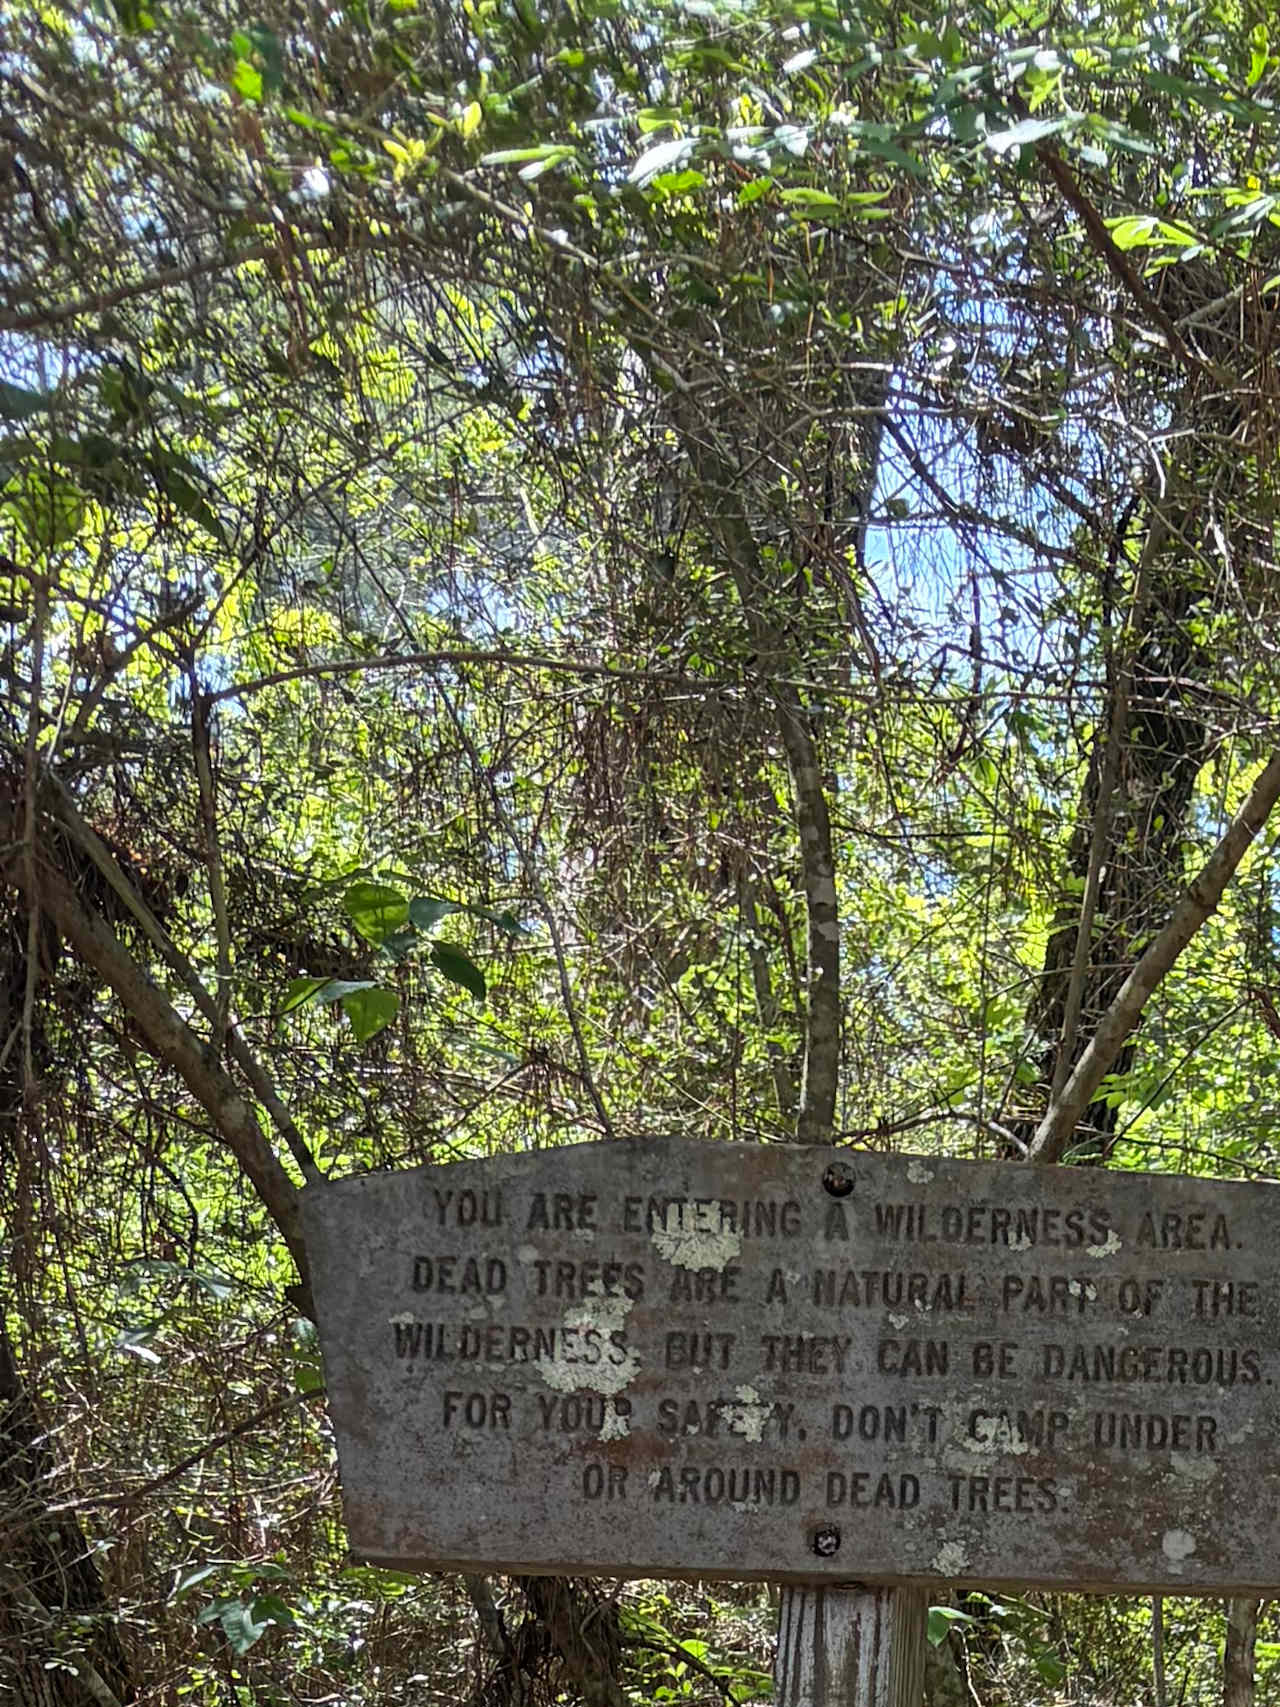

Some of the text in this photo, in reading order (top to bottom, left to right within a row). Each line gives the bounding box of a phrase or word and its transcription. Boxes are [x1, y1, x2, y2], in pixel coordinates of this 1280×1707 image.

[434, 1188, 1243, 1251] YOU ARE ENTERING A WILDERNESS AREA.
[412, 1256, 1262, 1319] DEAD TREES ARE A NATURAL PART OF THE
[665, 1331, 737, 1371] BUT
[762, 1335, 851, 1375] THEY
[877, 1338, 949, 1377] CAN
[972, 1341, 1019, 1380] BE
[1043, 1343, 1273, 1387] DANGEROUS.
[442, 1390, 512, 1430] FOR
[537, 1394, 633, 1433] YOUR
[832, 1404, 943, 1444] DON'T
[967, 1407, 1069, 1447] CAMP
[1096, 1411, 1219, 1452] UNDER
[582, 1464, 1070, 1515] OR AROUND DEAD TREES.
